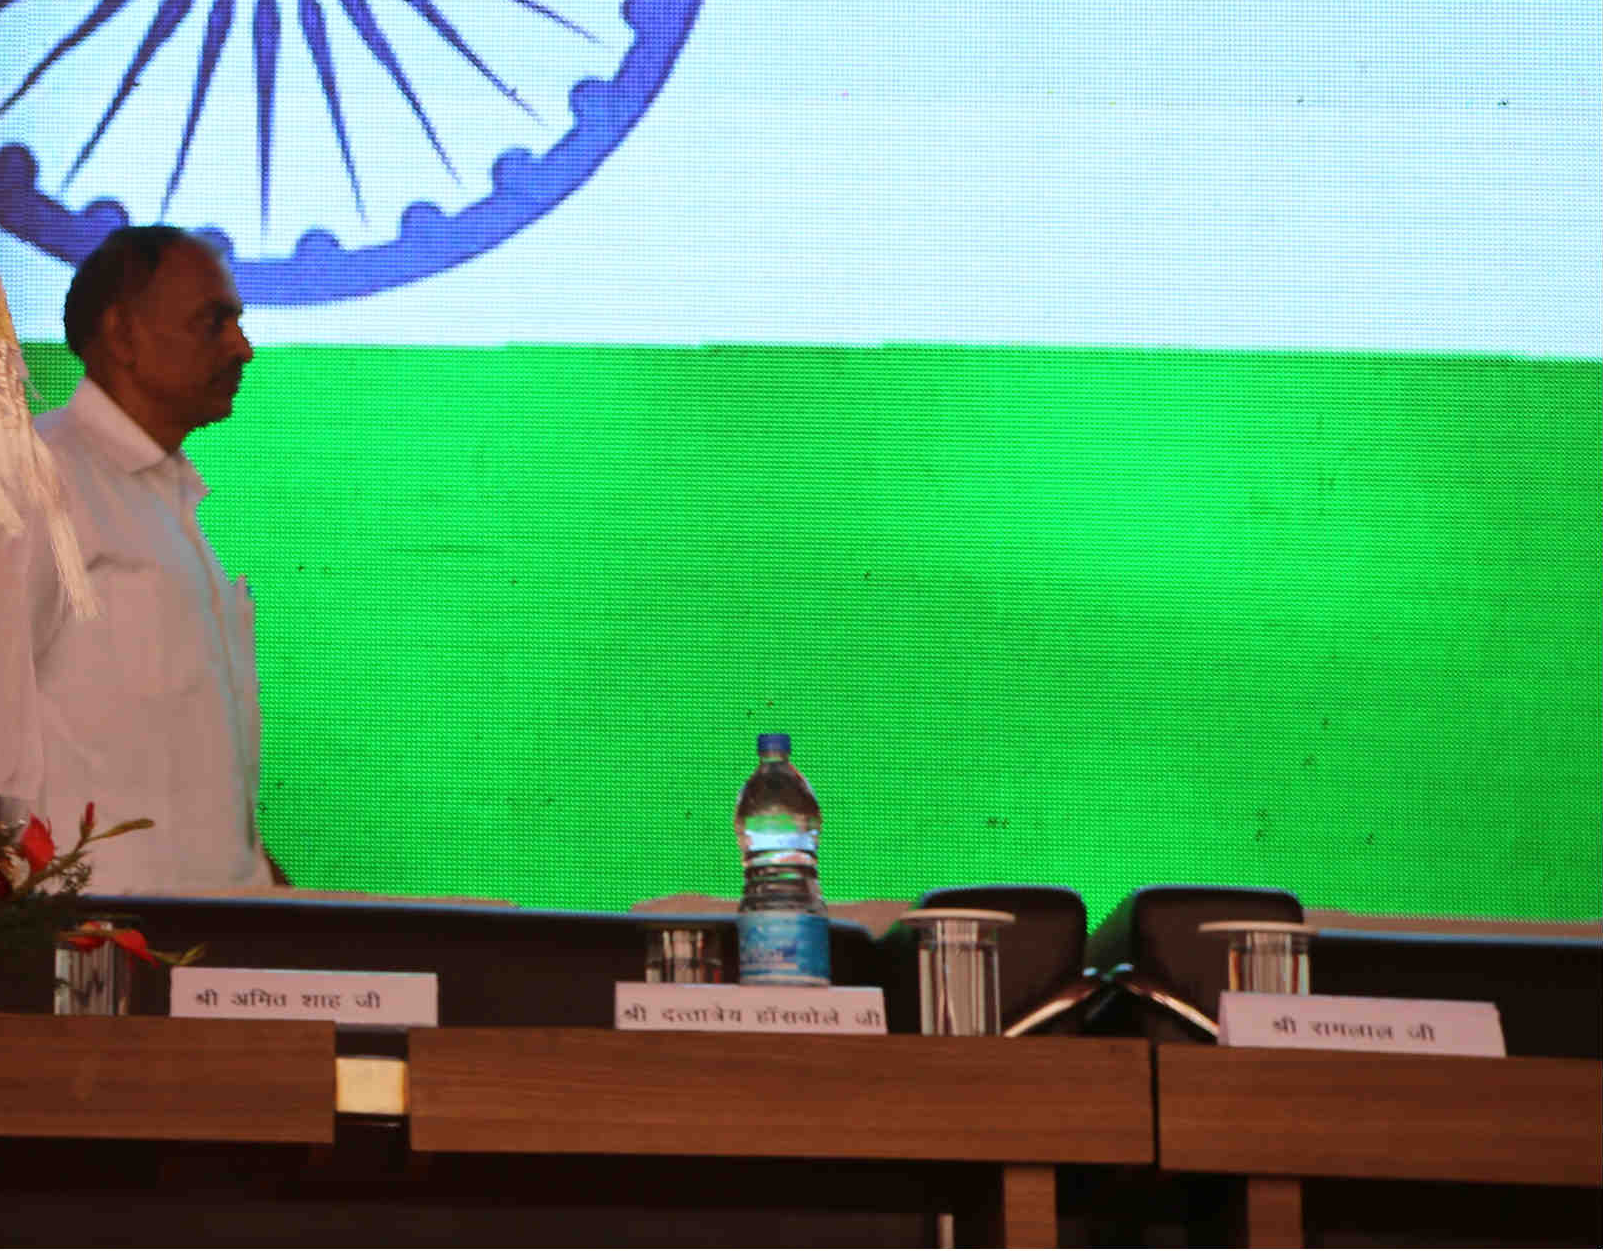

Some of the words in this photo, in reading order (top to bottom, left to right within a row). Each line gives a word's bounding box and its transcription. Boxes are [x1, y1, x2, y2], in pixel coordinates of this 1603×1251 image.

[195, 989, 218, 1006] श्री
[231, 988, 287, 1007] अमित
[301, 993, 341, 1008] शाह
[355, 992, 381, 1009] जी
[622, 1003, 647, 1022] श्री
[855, 1009, 880, 1027] जी
[1273, 1017, 1297, 1033] श्री
[1311, 1022, 1393, 1040] रामलाल
[1408, 1023, 1435, 1041] जी
